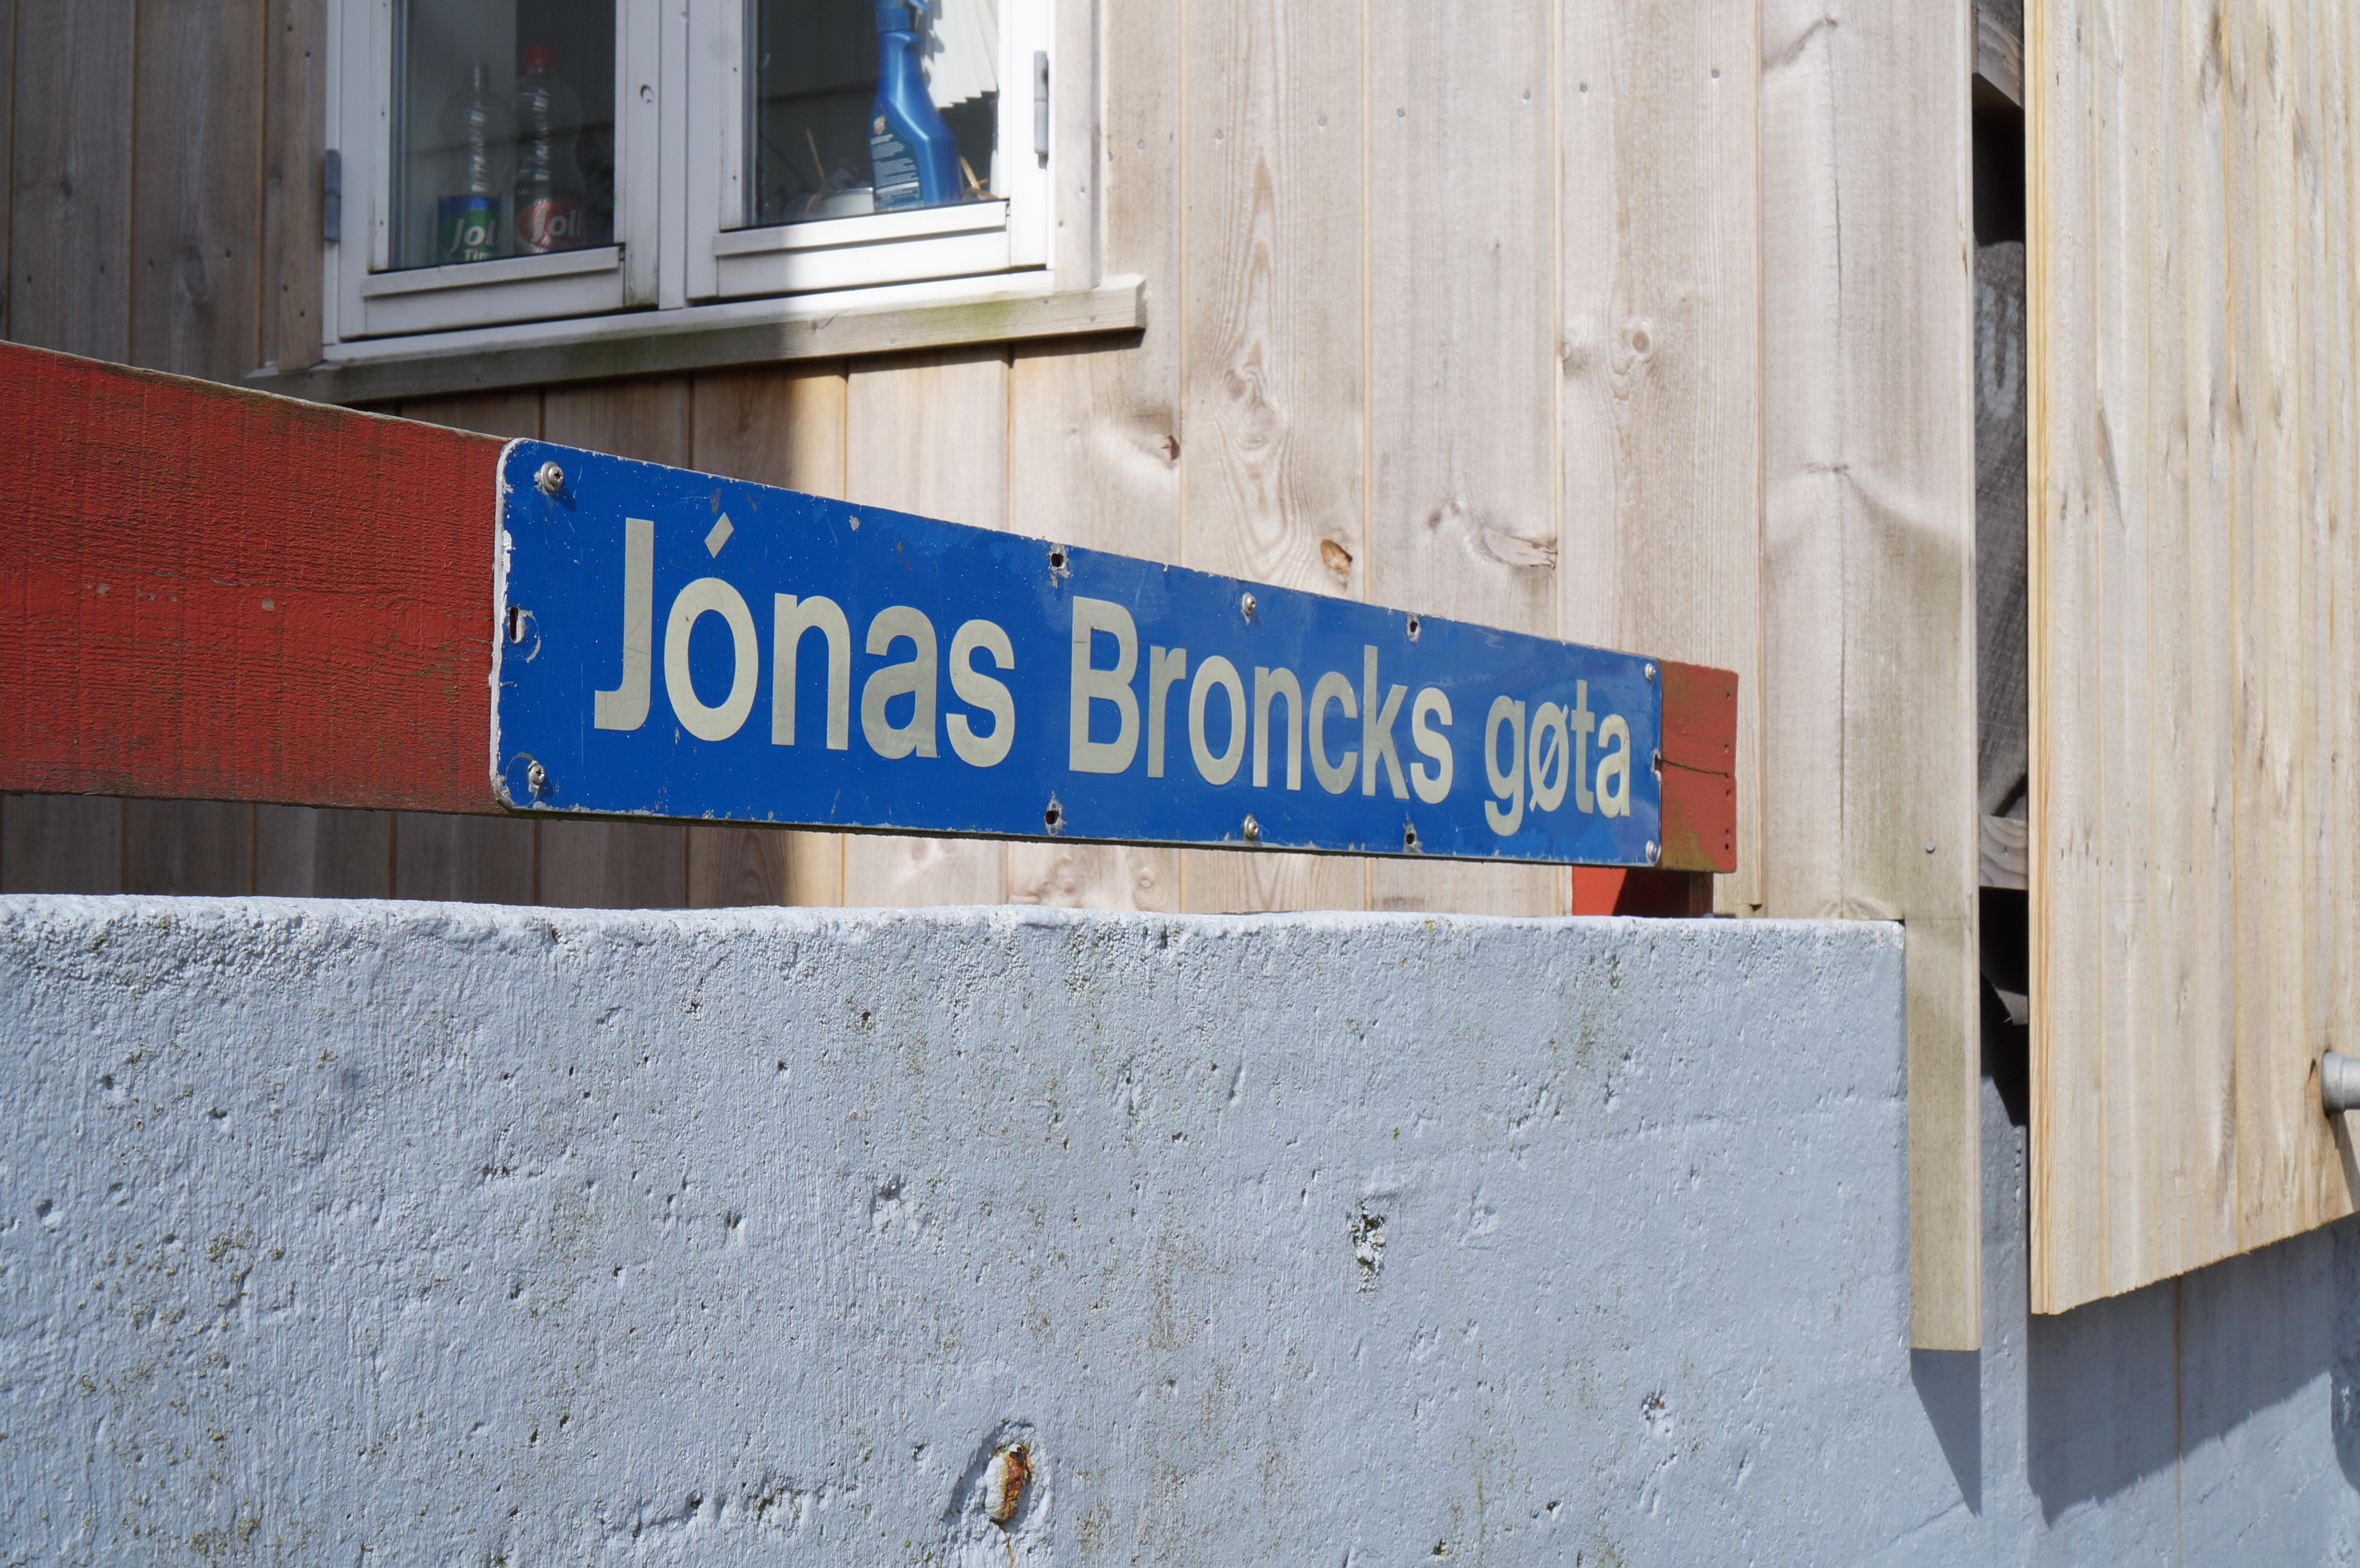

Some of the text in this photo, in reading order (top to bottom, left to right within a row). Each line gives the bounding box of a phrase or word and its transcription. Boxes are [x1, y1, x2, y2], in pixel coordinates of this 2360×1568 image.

[594, 512, 1632, 837] Jónas Broncks gøta
